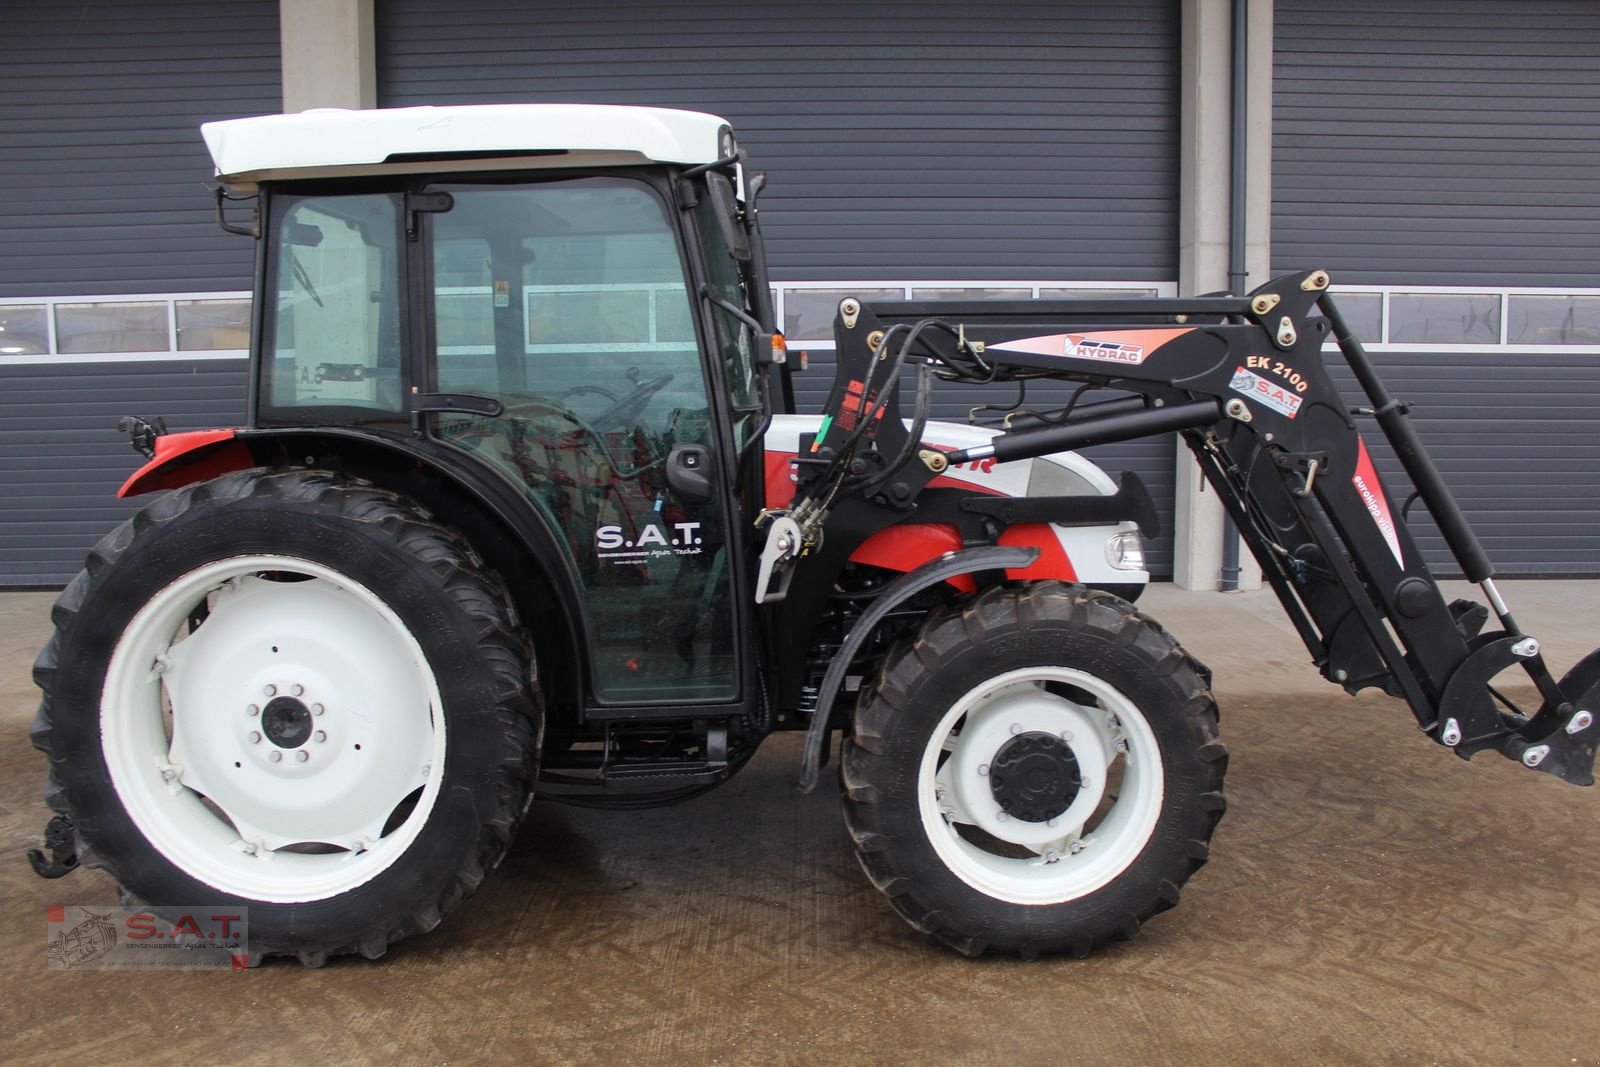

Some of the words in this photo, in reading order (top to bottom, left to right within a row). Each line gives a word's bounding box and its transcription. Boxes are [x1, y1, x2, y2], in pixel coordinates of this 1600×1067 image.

[1076, 347, 1138, 362] HYDRAC
[1246, 355, 1271, 370] EK
[1272, 361, 1308, 393] 2100
[1256, 380, 1300, 409] S.A.T.
[1354, 475, 1381, 517] eurokipp
[596, 522, 702, 549] S.A.T.
